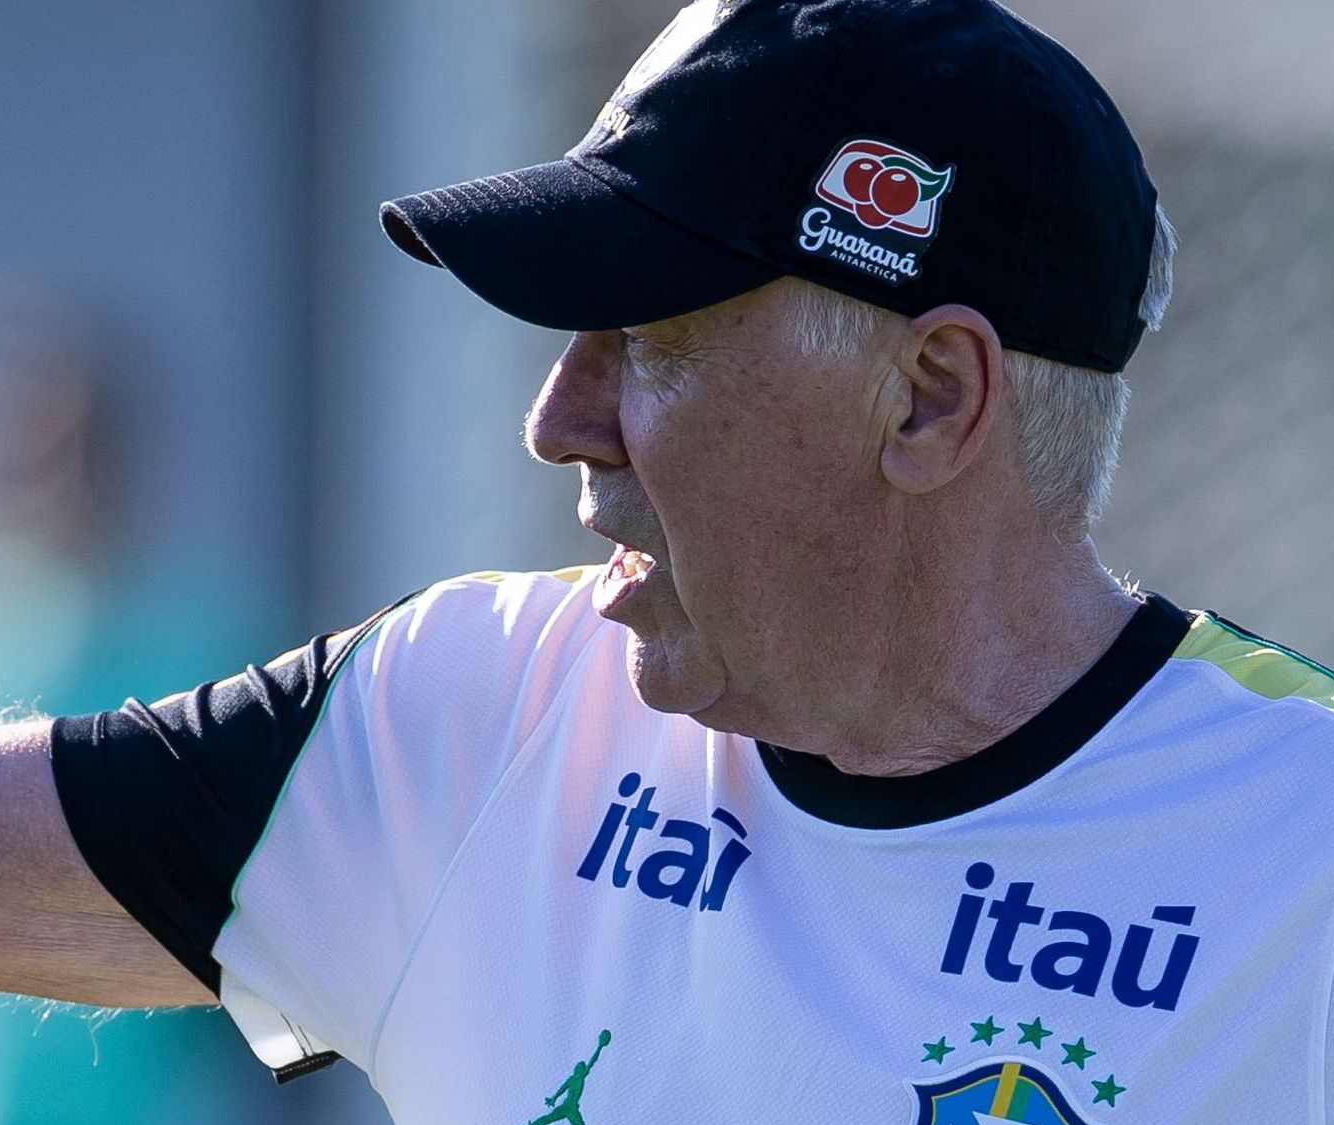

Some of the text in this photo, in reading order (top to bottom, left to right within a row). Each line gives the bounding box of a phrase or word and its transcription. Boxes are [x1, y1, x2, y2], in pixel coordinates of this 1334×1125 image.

[799, 207, 918, 276] Guaraná
[830, 250, 898, 282] ANTARCTICA
[939, 862, 1200, 1012] itaú
